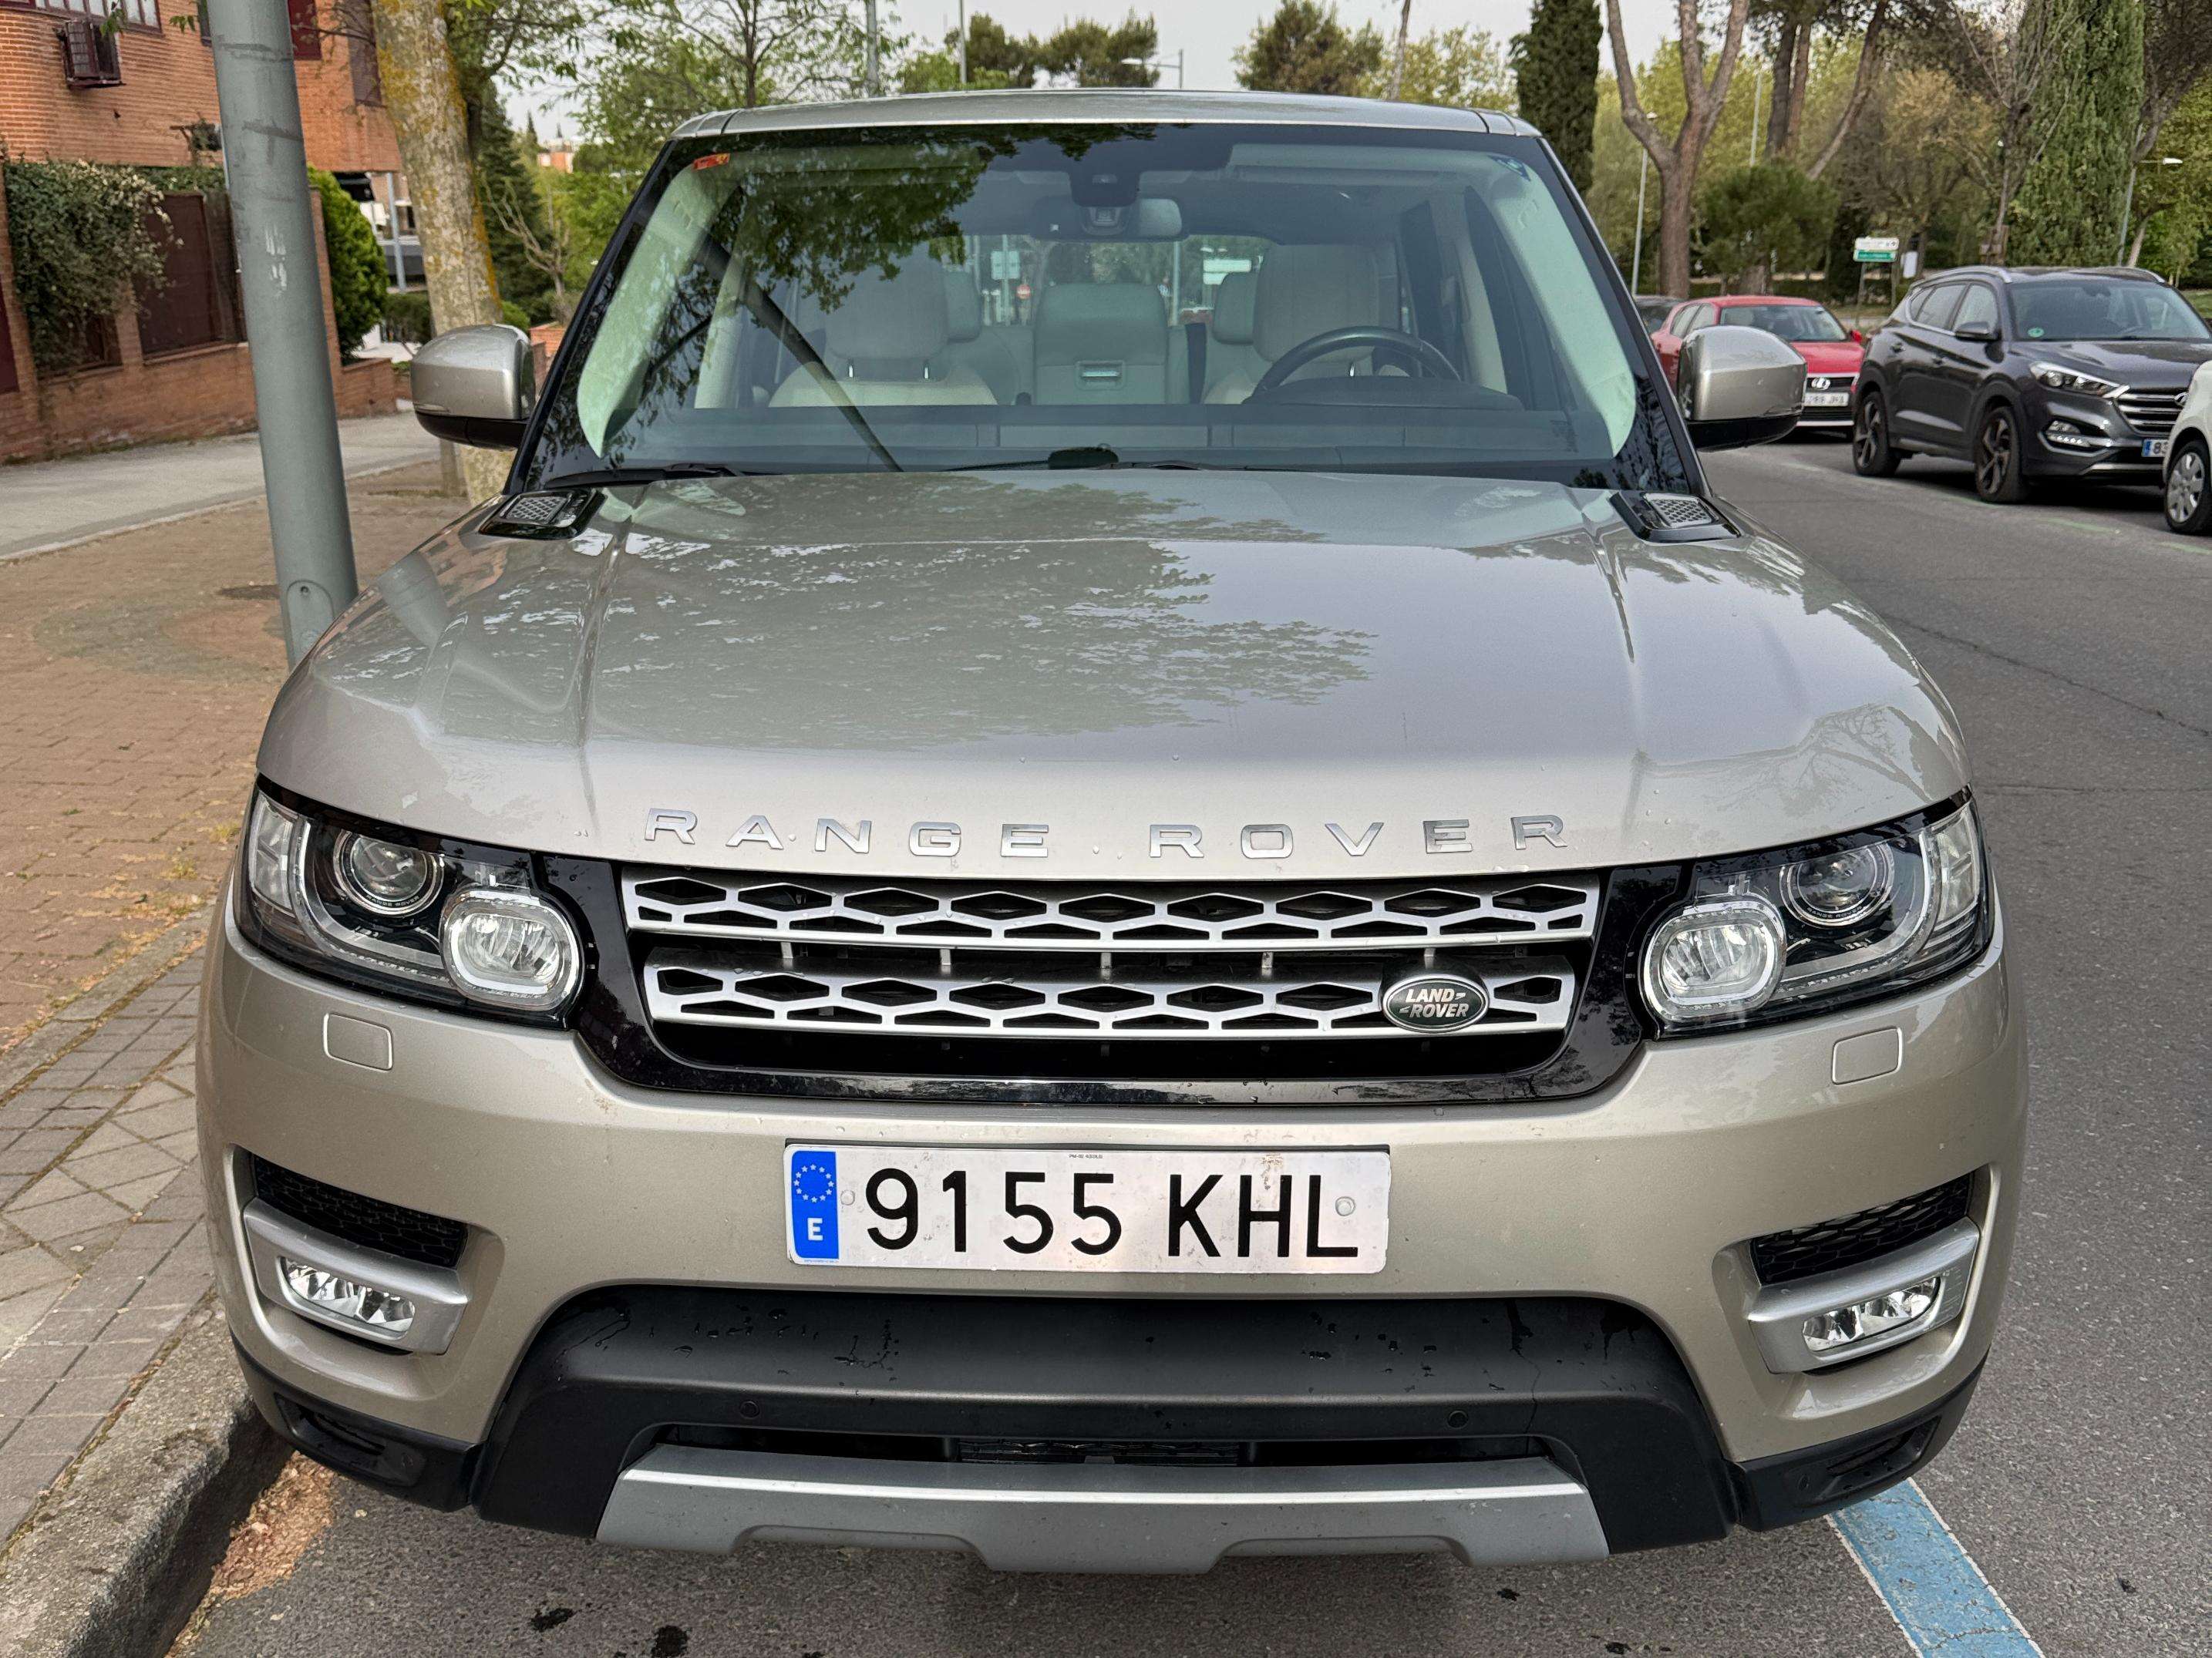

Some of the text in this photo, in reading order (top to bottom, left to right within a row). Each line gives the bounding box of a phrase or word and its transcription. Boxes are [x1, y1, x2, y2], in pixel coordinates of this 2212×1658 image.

[645, 807, 1568, 859] RANGE ROVER
[1405, 988, 1455, 1003] LAND
[1409, 1003, 1470, 1018] ROVER
[865, 1167, 1359, 1258] 9155 KHL
[807, 1217, 823, 1241] E
